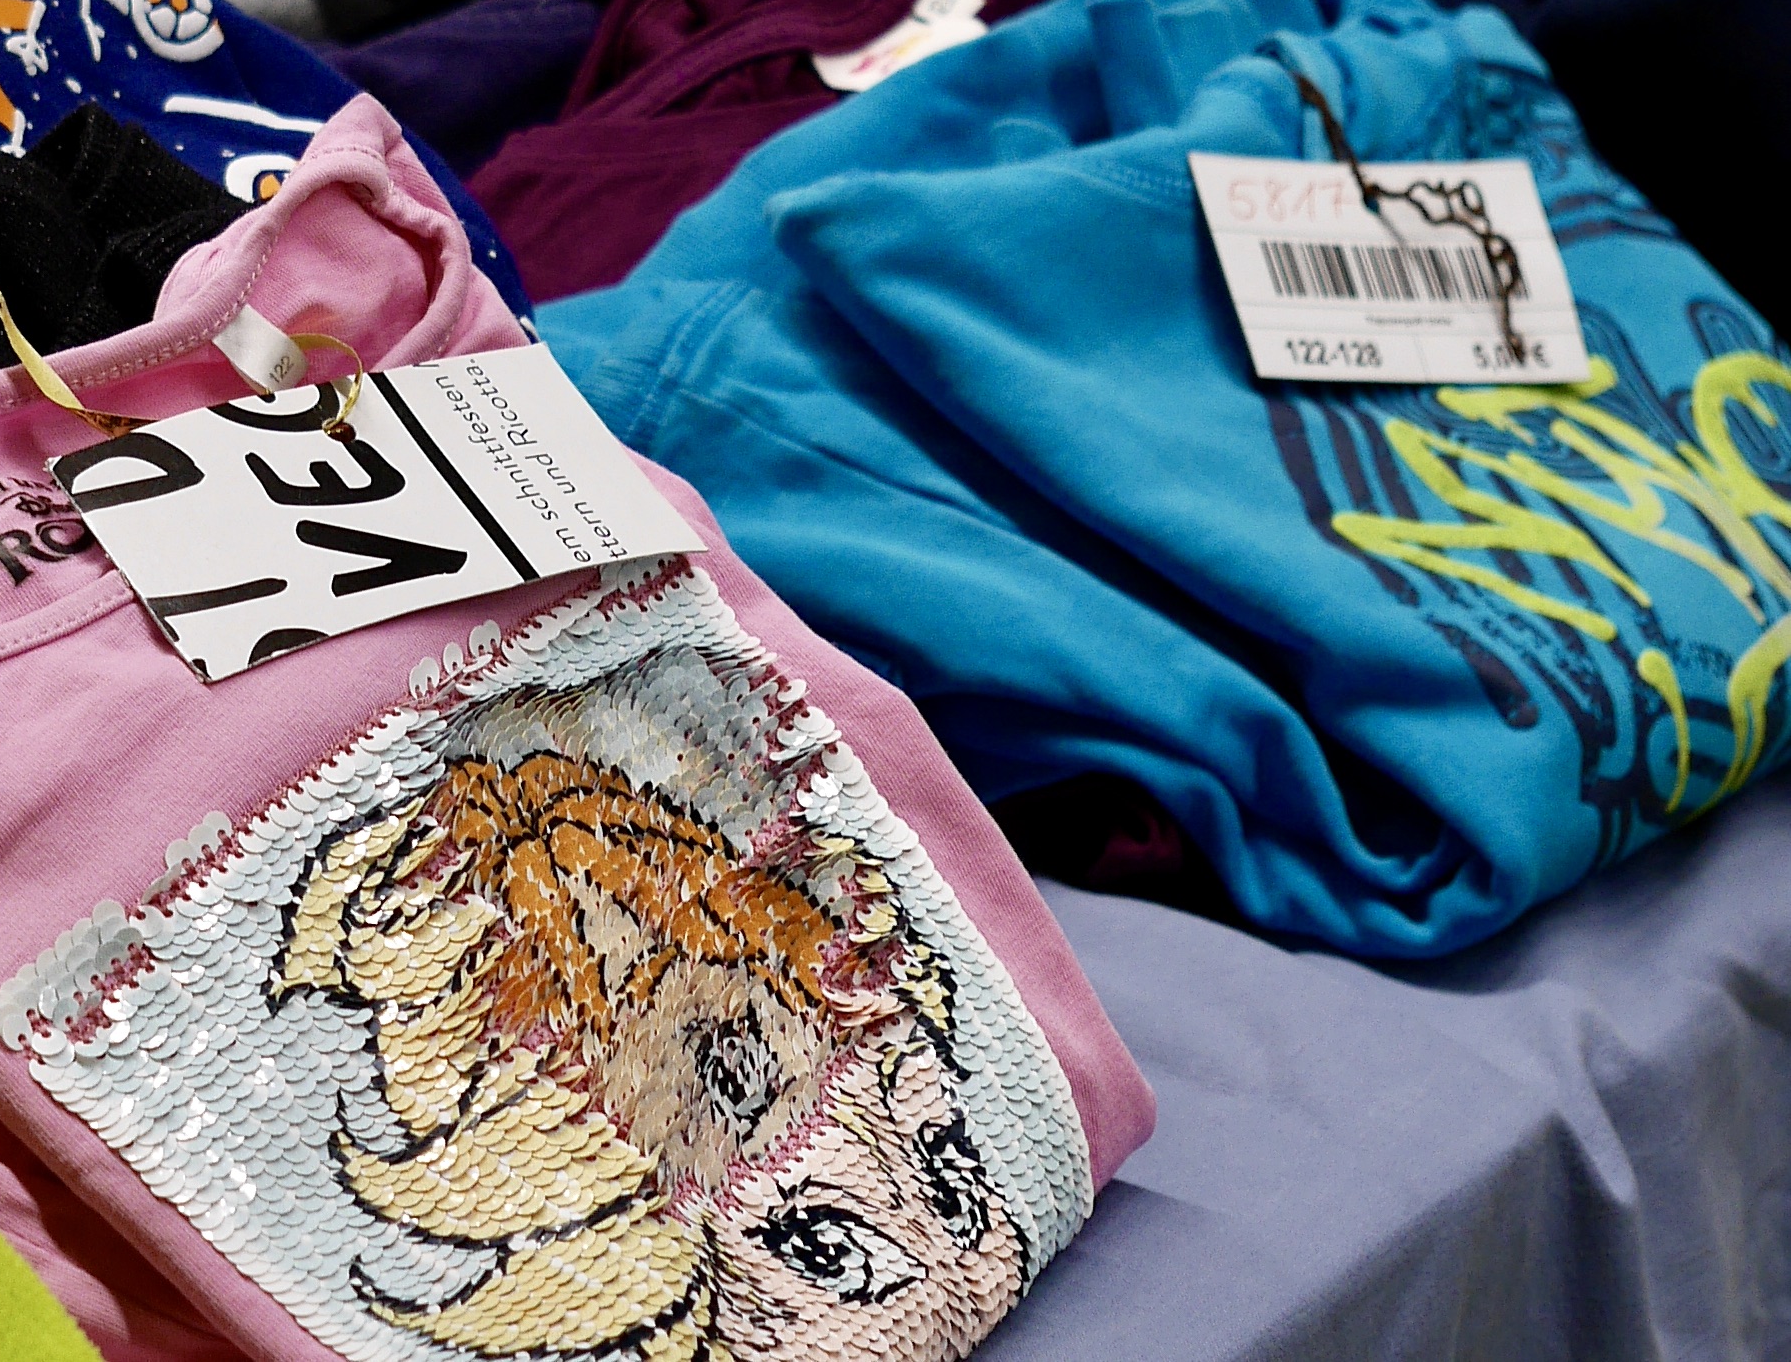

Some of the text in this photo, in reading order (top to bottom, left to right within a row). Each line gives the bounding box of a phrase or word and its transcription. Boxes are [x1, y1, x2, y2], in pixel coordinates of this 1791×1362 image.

[1284, 338, 1383, 367] 122-128
[1531, 342, 1553, 369] €
[269, 355, 293, 385] 122
[435, 375, 591, 563] em schnittfesten
[466, 358, 628, 559] ttern und Ricotta.
